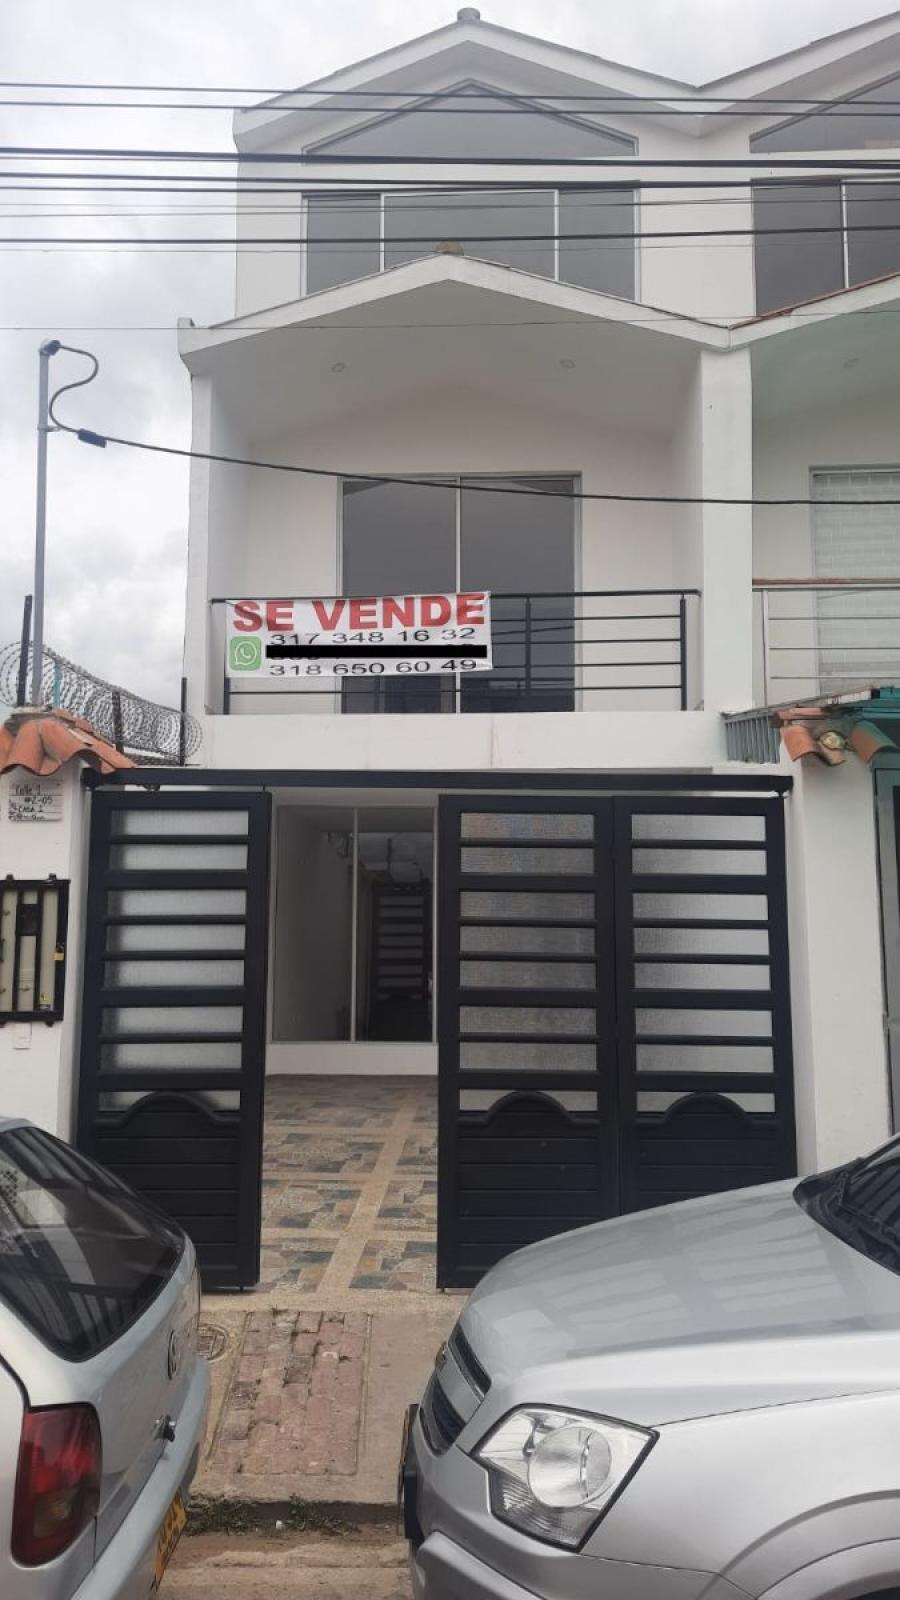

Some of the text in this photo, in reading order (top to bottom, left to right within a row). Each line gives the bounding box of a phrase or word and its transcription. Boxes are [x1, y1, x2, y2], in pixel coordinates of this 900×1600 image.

[233, 593, 484, 632] SE VENDE
[270, 627, 475, 645] 317 348 16 32
[269, 659, 476, 676] 318 650 60 49
